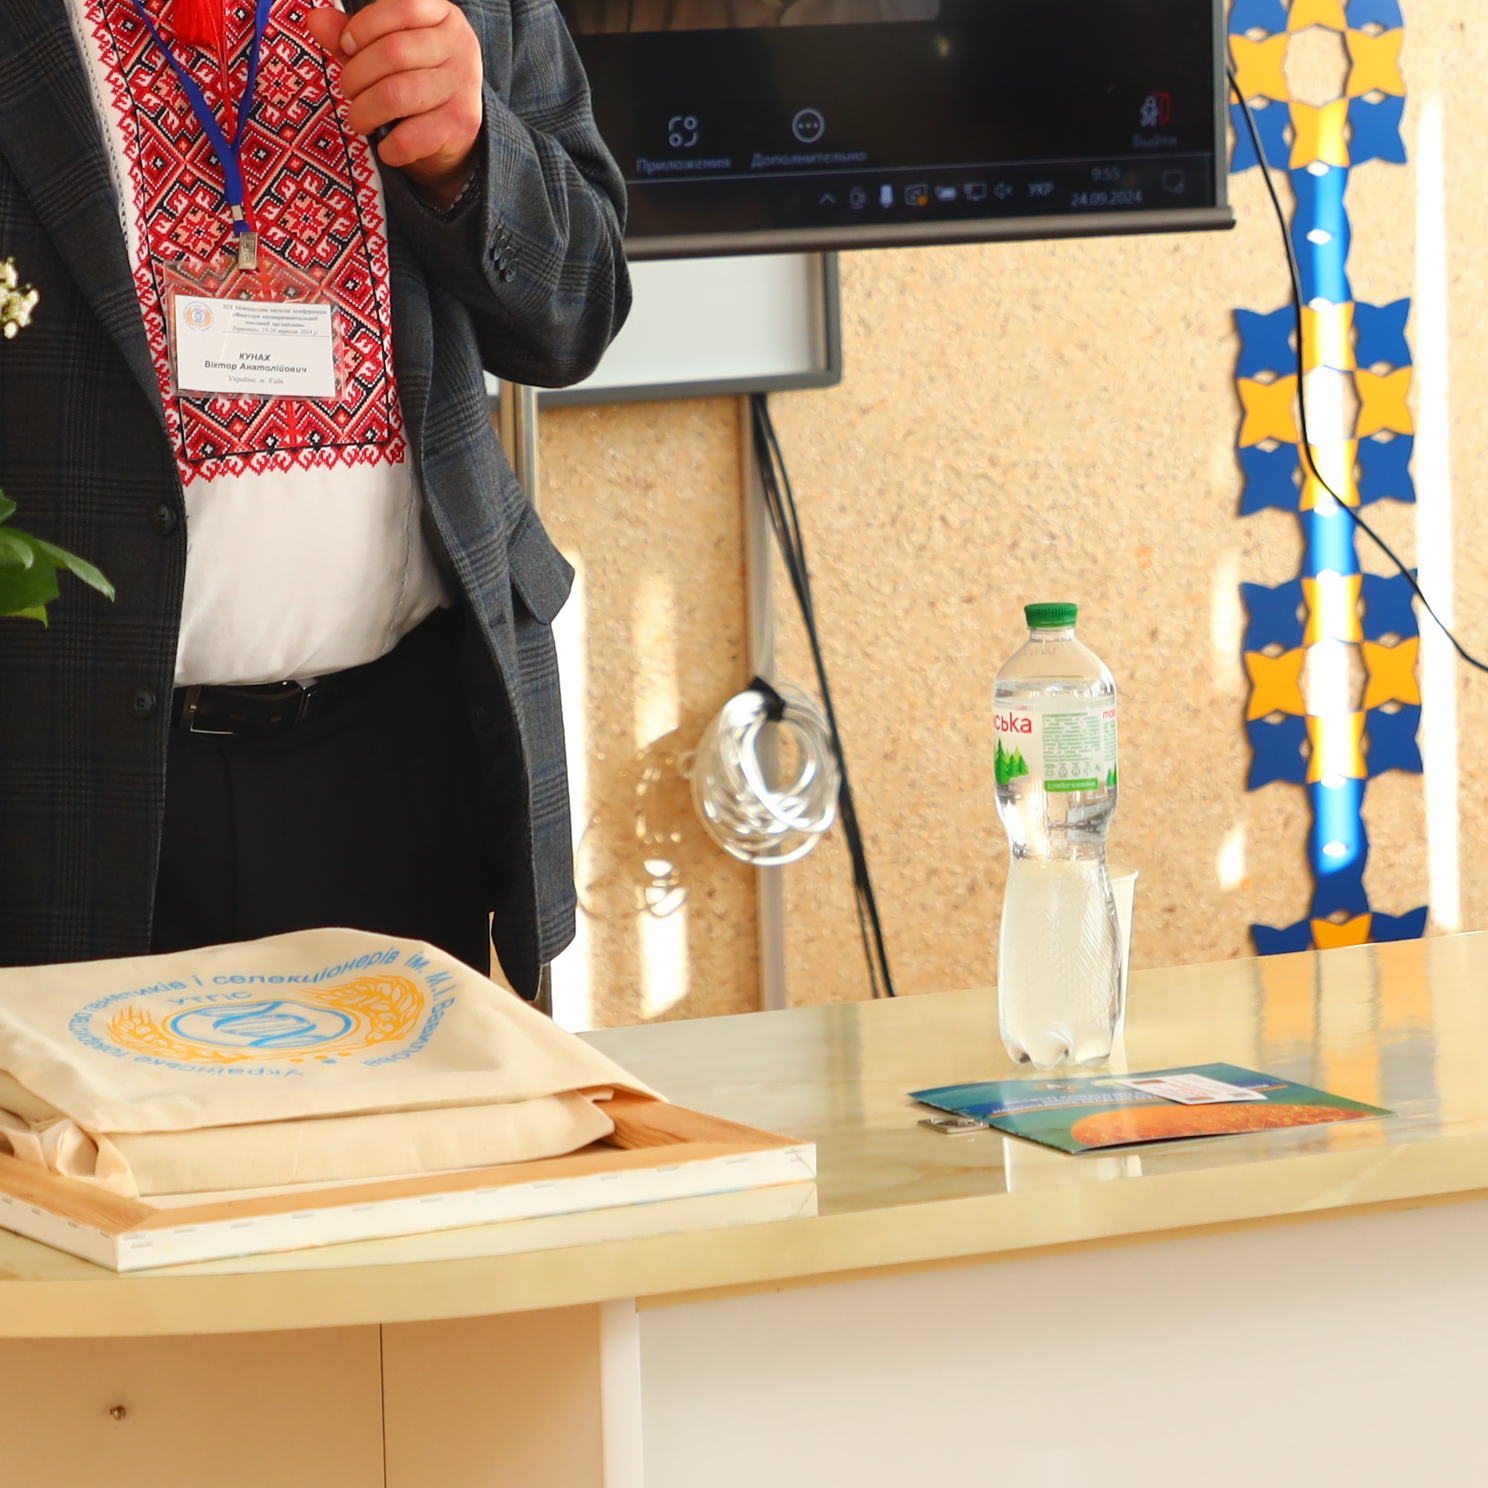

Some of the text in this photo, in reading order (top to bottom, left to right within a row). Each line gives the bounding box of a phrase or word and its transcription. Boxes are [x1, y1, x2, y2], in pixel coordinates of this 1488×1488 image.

[204, 360, 308, 373] Віктор Анатолійович
[239, 353, 271, 362] КУНАХ
[992, 711, 1032, 734] ська
[212, 946, 400, 985] селекціонерів
